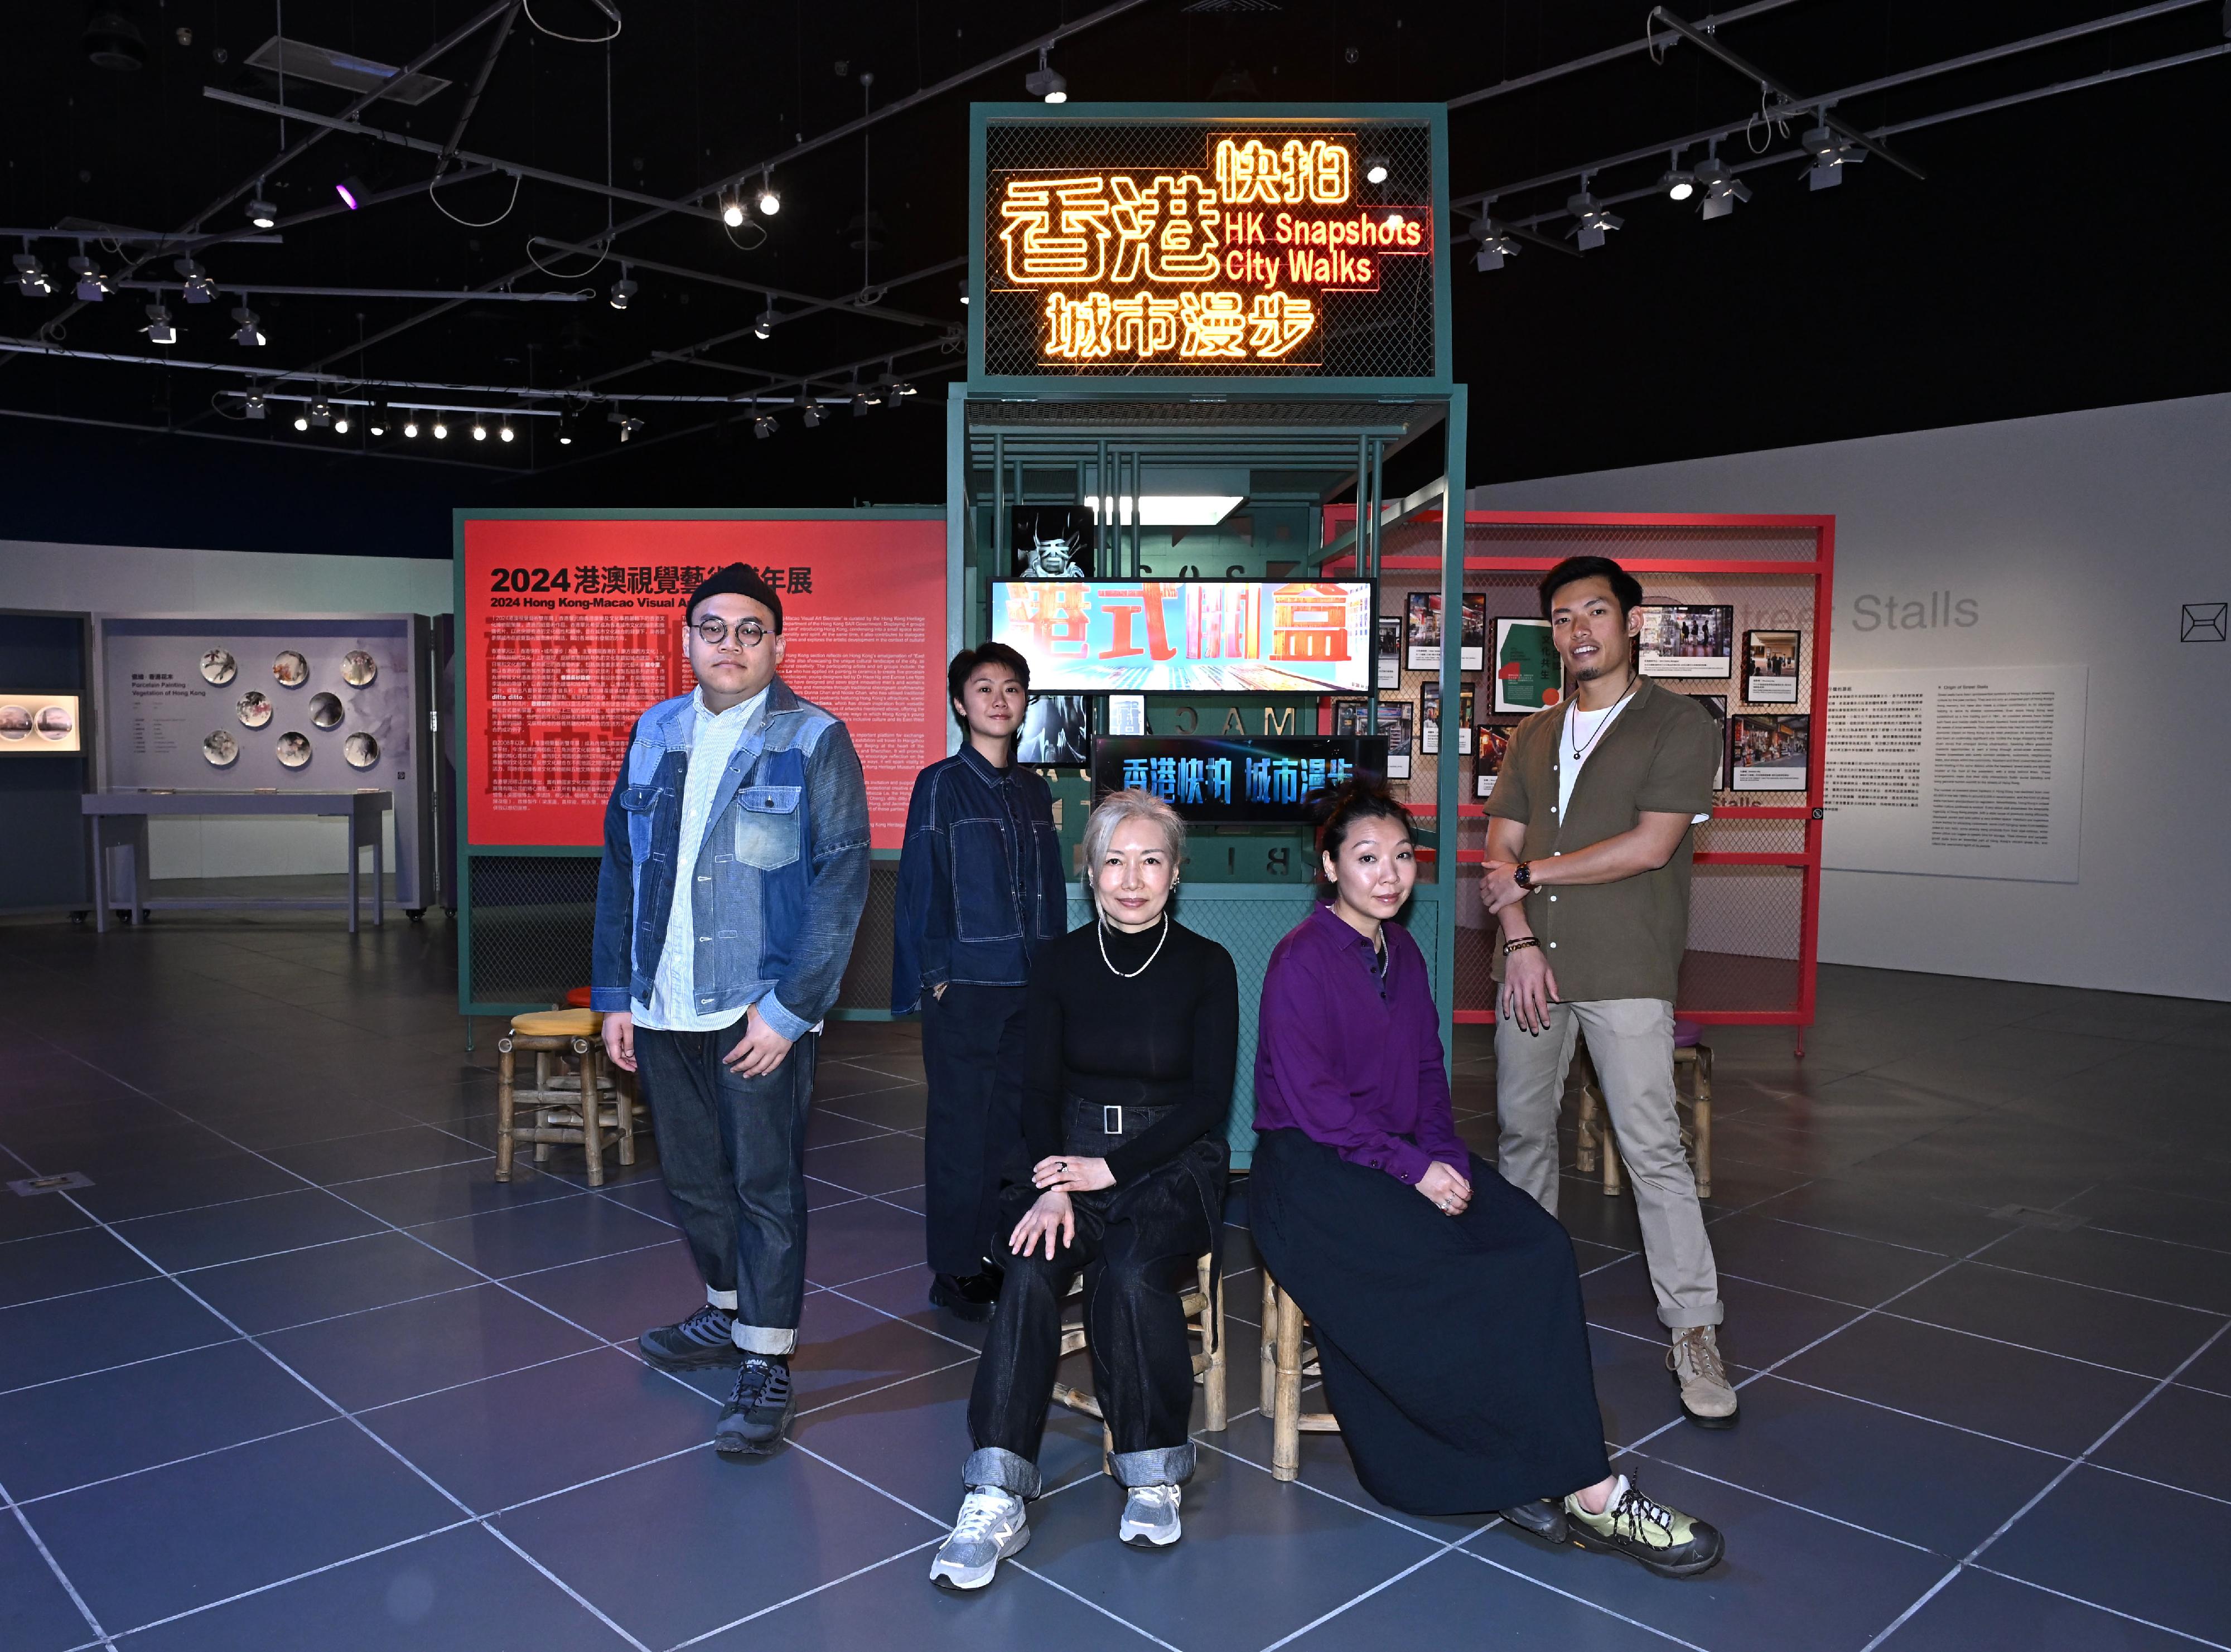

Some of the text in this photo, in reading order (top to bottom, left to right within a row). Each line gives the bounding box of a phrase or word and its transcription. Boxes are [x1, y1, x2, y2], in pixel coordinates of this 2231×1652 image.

[1215, 139, 1349, 204] 快拍
[999, 175, 1220, 283] 香港
[1225, 211, 1421, 253] HK Snapshots
[1226, 248, 1372, 289] City Walks
[1045, 291, 1315, 358] 城市漫步
[490, 565, 813, 595] 2024港澳視覺藝年展
[491, 597, 520, 607] 2024
[523, 597, 555, 610] Hong
[558, 597, 634, 610] Kong-Macao
[637, 597, 674, 607] Visual
[1852, 590, 1979, 632] Stalls
[1123, 757, 1232, 804] 香港快拍
